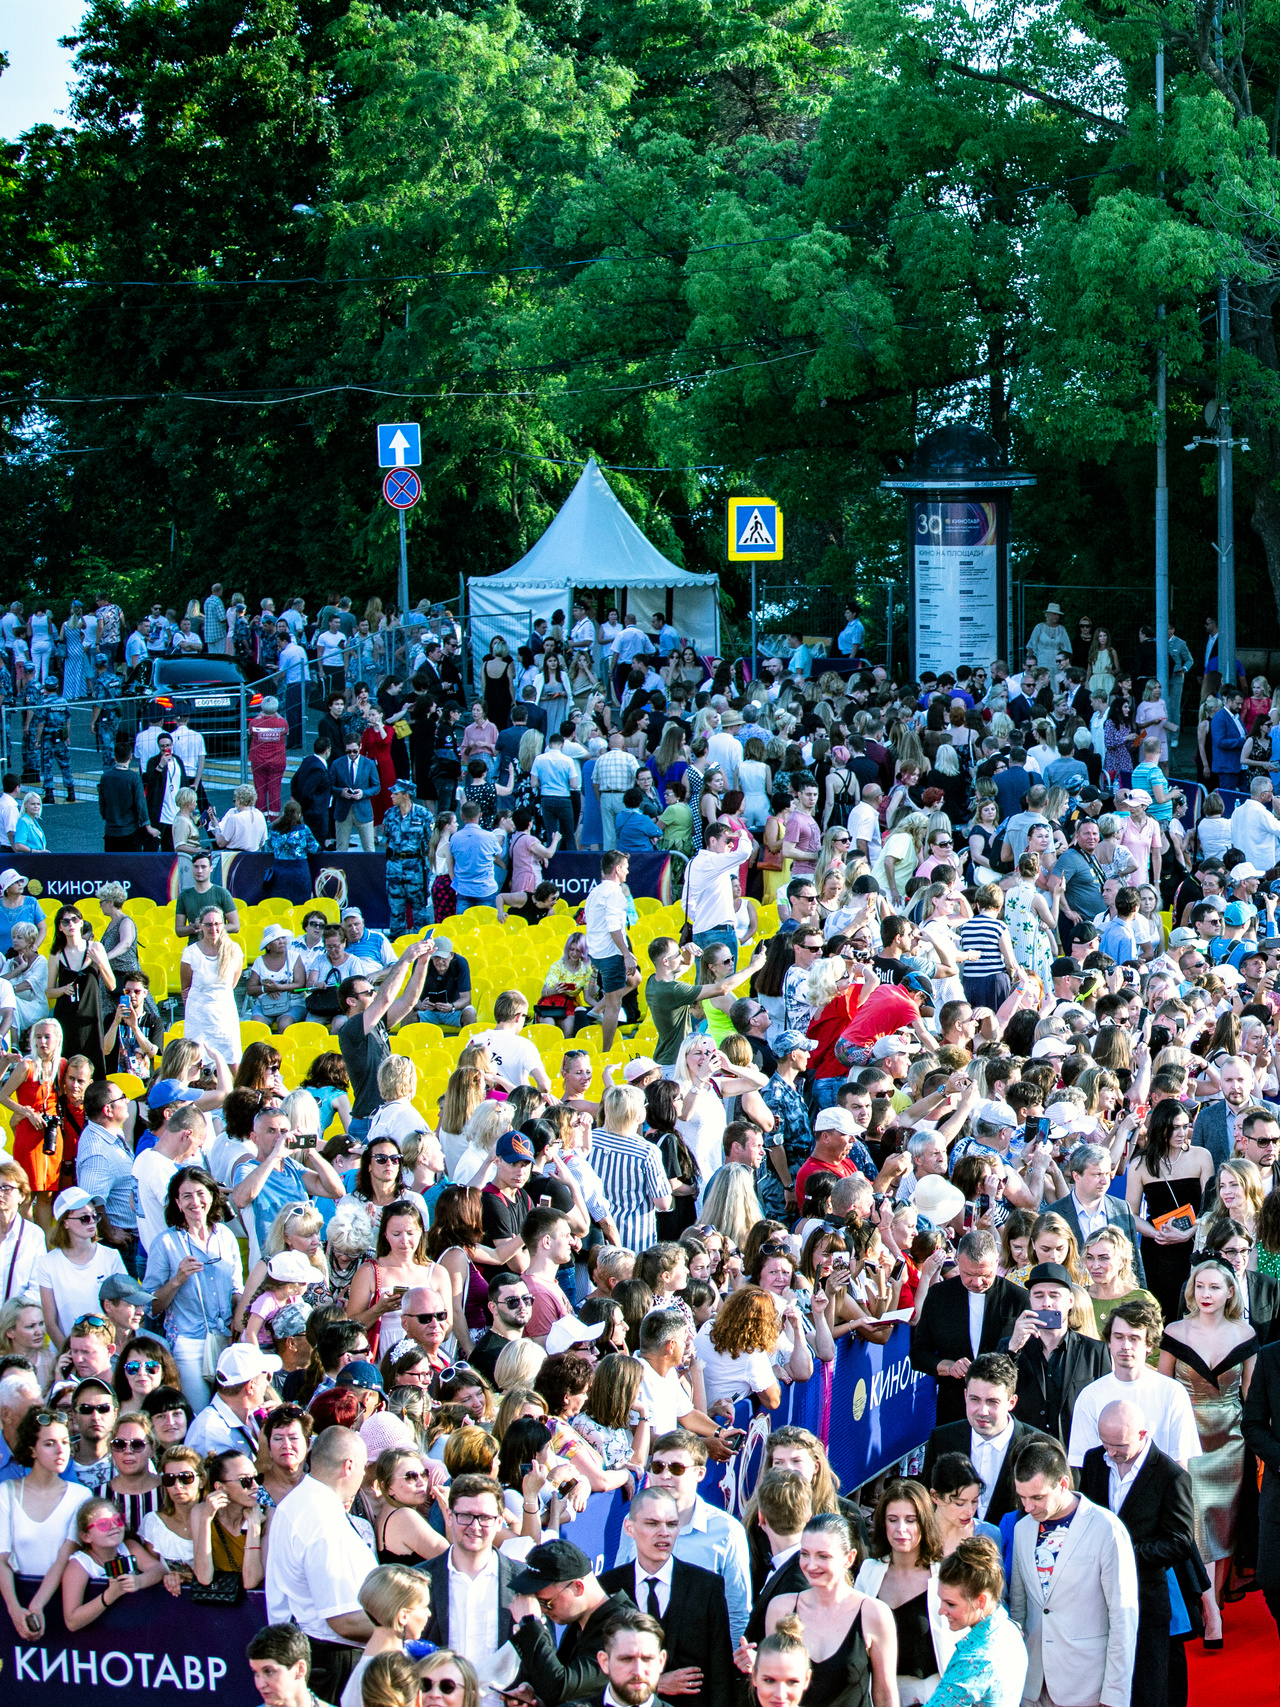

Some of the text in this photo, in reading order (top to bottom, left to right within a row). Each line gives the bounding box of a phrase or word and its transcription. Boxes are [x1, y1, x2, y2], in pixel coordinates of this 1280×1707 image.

[917, 513, 942, 535] 30
[47, 880, 131, 895] КИНОТР
[875, 967, 894, 985] Bull
[870, 1355, 926, 1410] КИНО
[14, 1646, 227, 1691] КИНОТАВР
